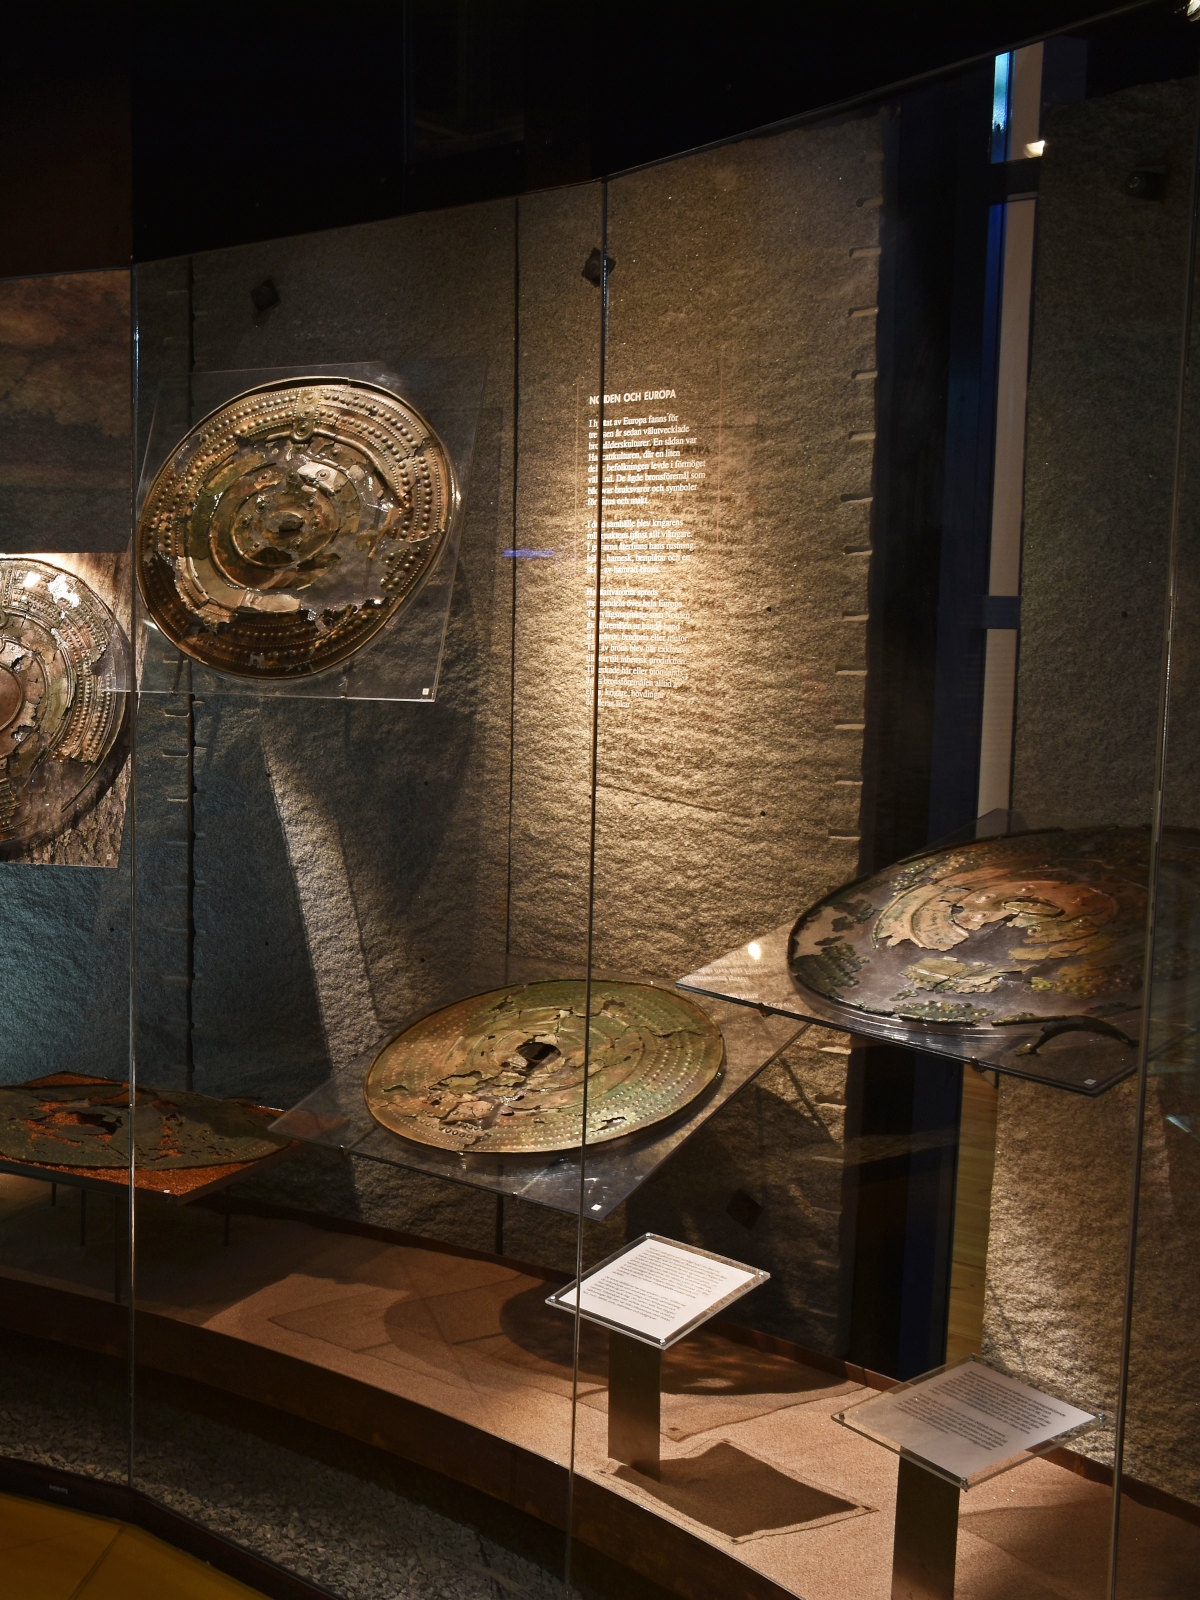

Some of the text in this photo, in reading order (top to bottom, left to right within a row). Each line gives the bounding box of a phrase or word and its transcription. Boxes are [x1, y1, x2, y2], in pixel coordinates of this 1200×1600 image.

[589, 389, 676, 405] NODEN OCH EUROPA
[589, 419, 593, 427] I
[623, 417, 647, 426] Europa
[648, 415, 667, 423] fanns
[668, 413, 679, 422] för
[615, 429, 622, 437] år
[623, 428, 642, 436] sedan
[643, 425, 690, 435] välutvecklade
[653, 438, 663, 446] En
[664, 437, 684, 446] sådan
[686, 436, 697, 444] var
[643, 449, 654, 459] där
[665, 448, 681, 457] liten
[607, 462, 649, 472] befolkningen
[650, 461, 670, 469] levde
[670, 460, 673, 468] i
[675, 459, 706, 469] förmöget
[616, 474, 626, 482] De
[627, 474, 643, 483] ägde
[644, 471, 689, 481] bronsföremål
[614, 485, 651, 494] bruksvaror
[651, 484, 664, 492] och
[665, 483, 698, 493] symboler
[617, 497, 629, 505] och
[607, 519, 635, 528] samhälle
[636, 519, 651, 527] blev
[652, 519, 683, 528] krigarens
